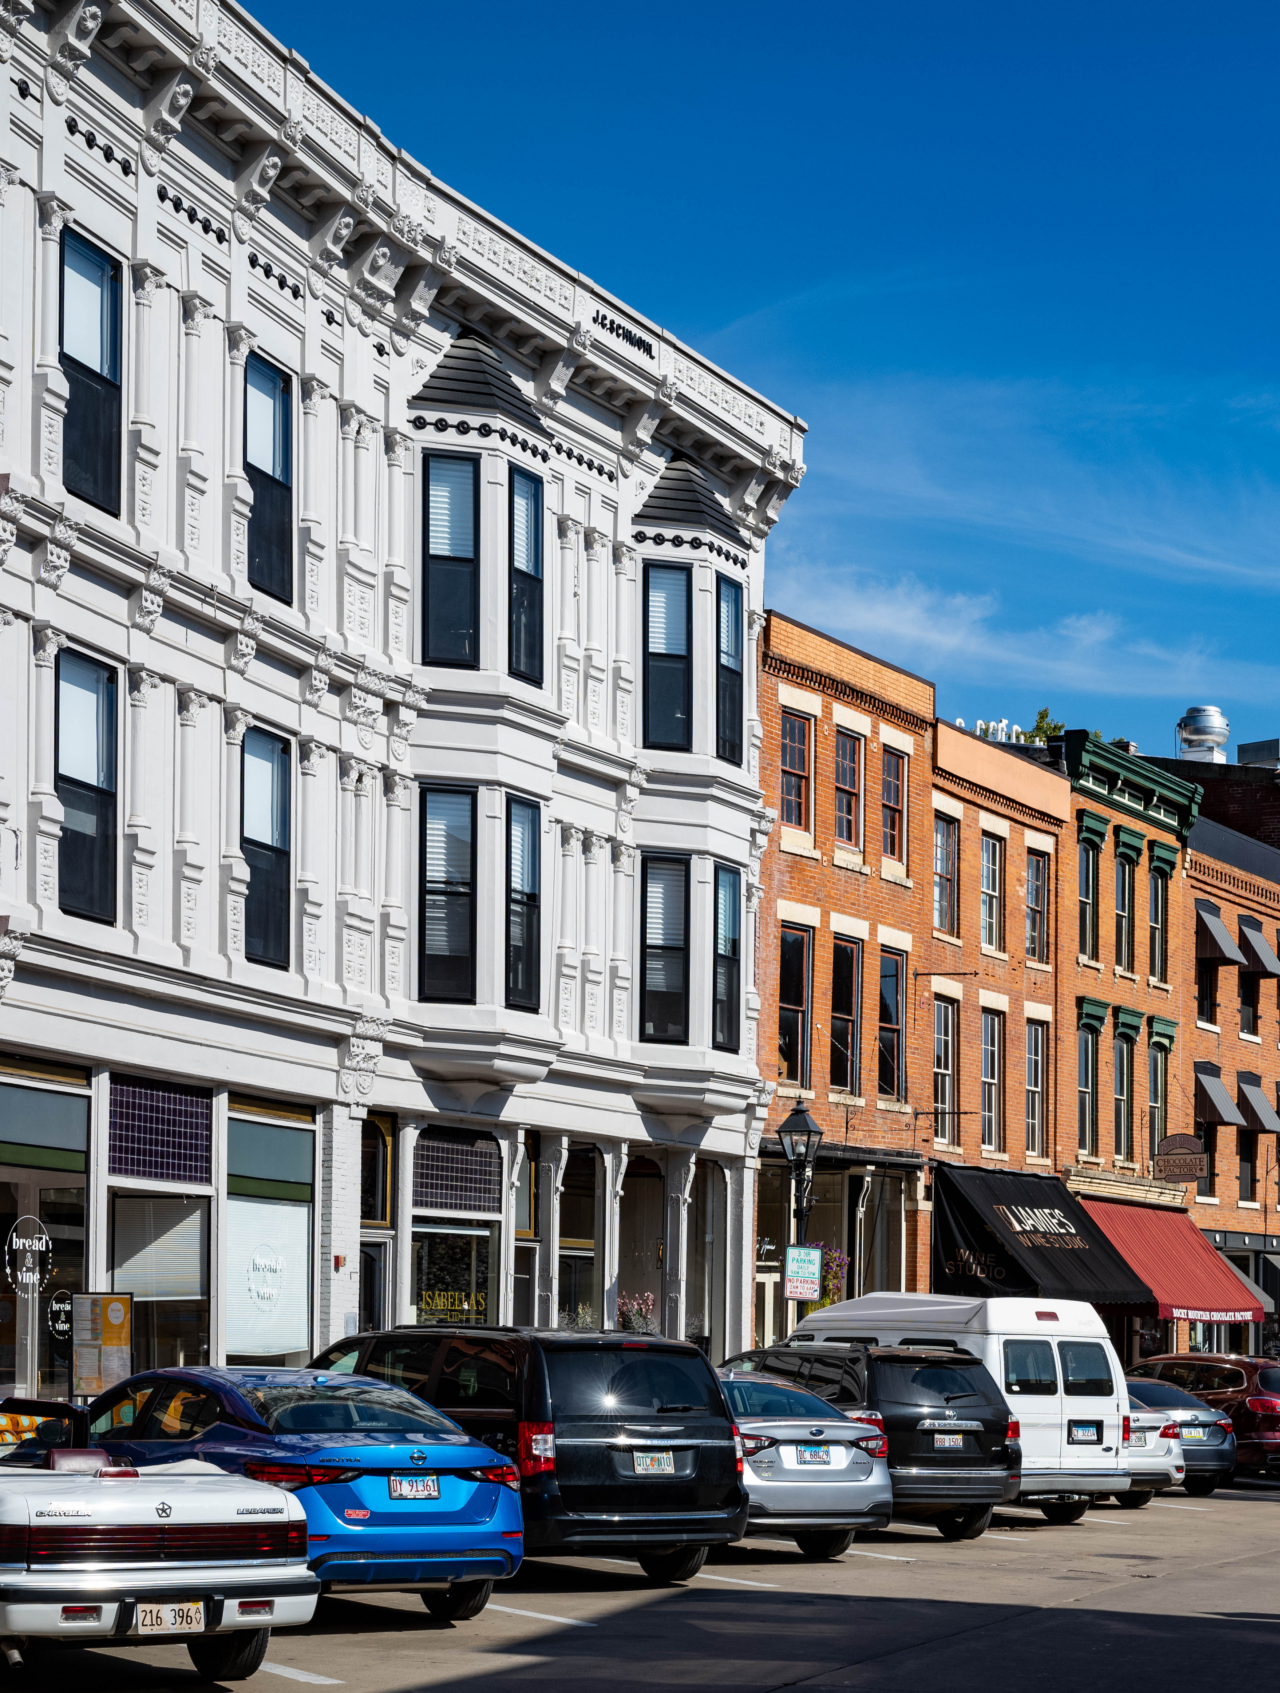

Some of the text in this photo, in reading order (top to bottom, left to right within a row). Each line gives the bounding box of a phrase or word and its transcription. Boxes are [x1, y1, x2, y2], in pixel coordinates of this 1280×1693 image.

[1156, 1157, 1205, 1168] CHOCOLATE
[1163, 1166, 1198, 1174] FACTORY
[1011, 1205, 1076, 1234] JAMIE'S
[13, 1232, 46, 1251] bread
[1015, 1233, 1089, 1249] WINE STUDIO
[792, 1257, 815, 1265] PARKING
[955, 1249, 996, 1265] WINE
[17, 1267, 40, 1284] vine
[945, 1261, 1006, 1279] STUDIO
[422, 1292, 485, 1310] ISABELLA'S
[447, 1312, 460, 1322] LTD
[1172, 1308, 1187, 1318] ROCKY
[1210, 1311, 1234, 1321] CHOCOLATE
[1235, 1311, 1253, 1320] FACTORY
[55, 1320, 70, 1331] vine
[391, 1478, 437, 1492] DY 91361
[35, 1509, 92, 1518] CHRYSLER
[141, 1607, 193, 1627] 216 396
